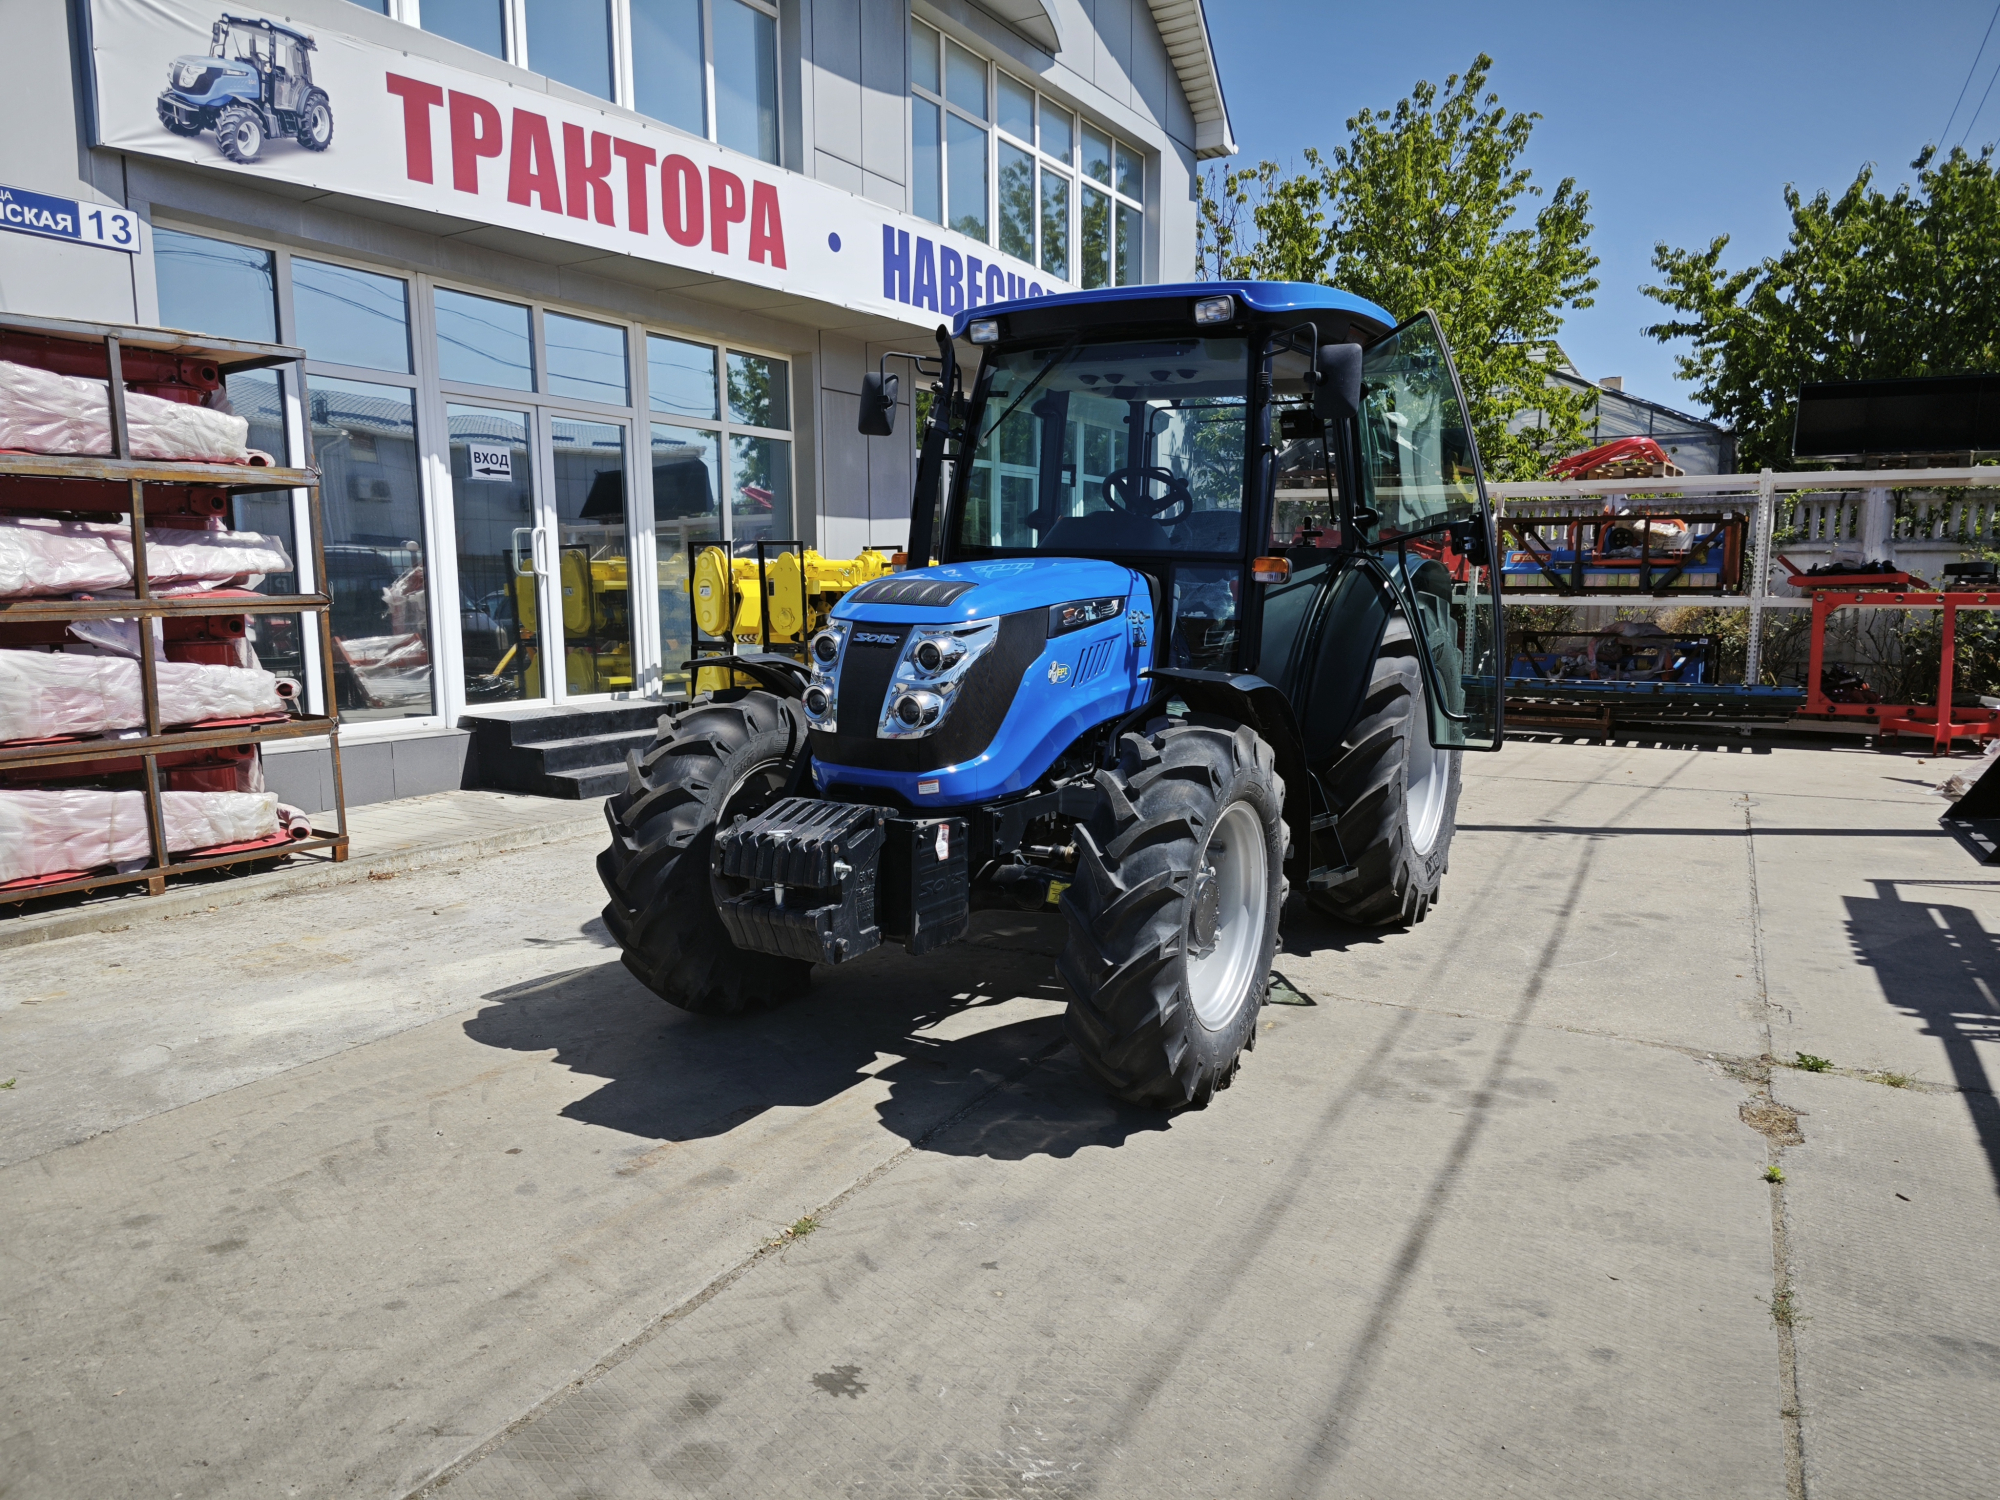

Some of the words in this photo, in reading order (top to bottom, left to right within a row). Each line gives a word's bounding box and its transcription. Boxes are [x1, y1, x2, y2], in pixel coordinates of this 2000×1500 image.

[385, 71, 787, 270] ТРАКТОРА
[882, 223, 1058, 317] НАВЕС
[88, 210, 132, 245] 13
[473, 451, 509, 468] ВХОД
